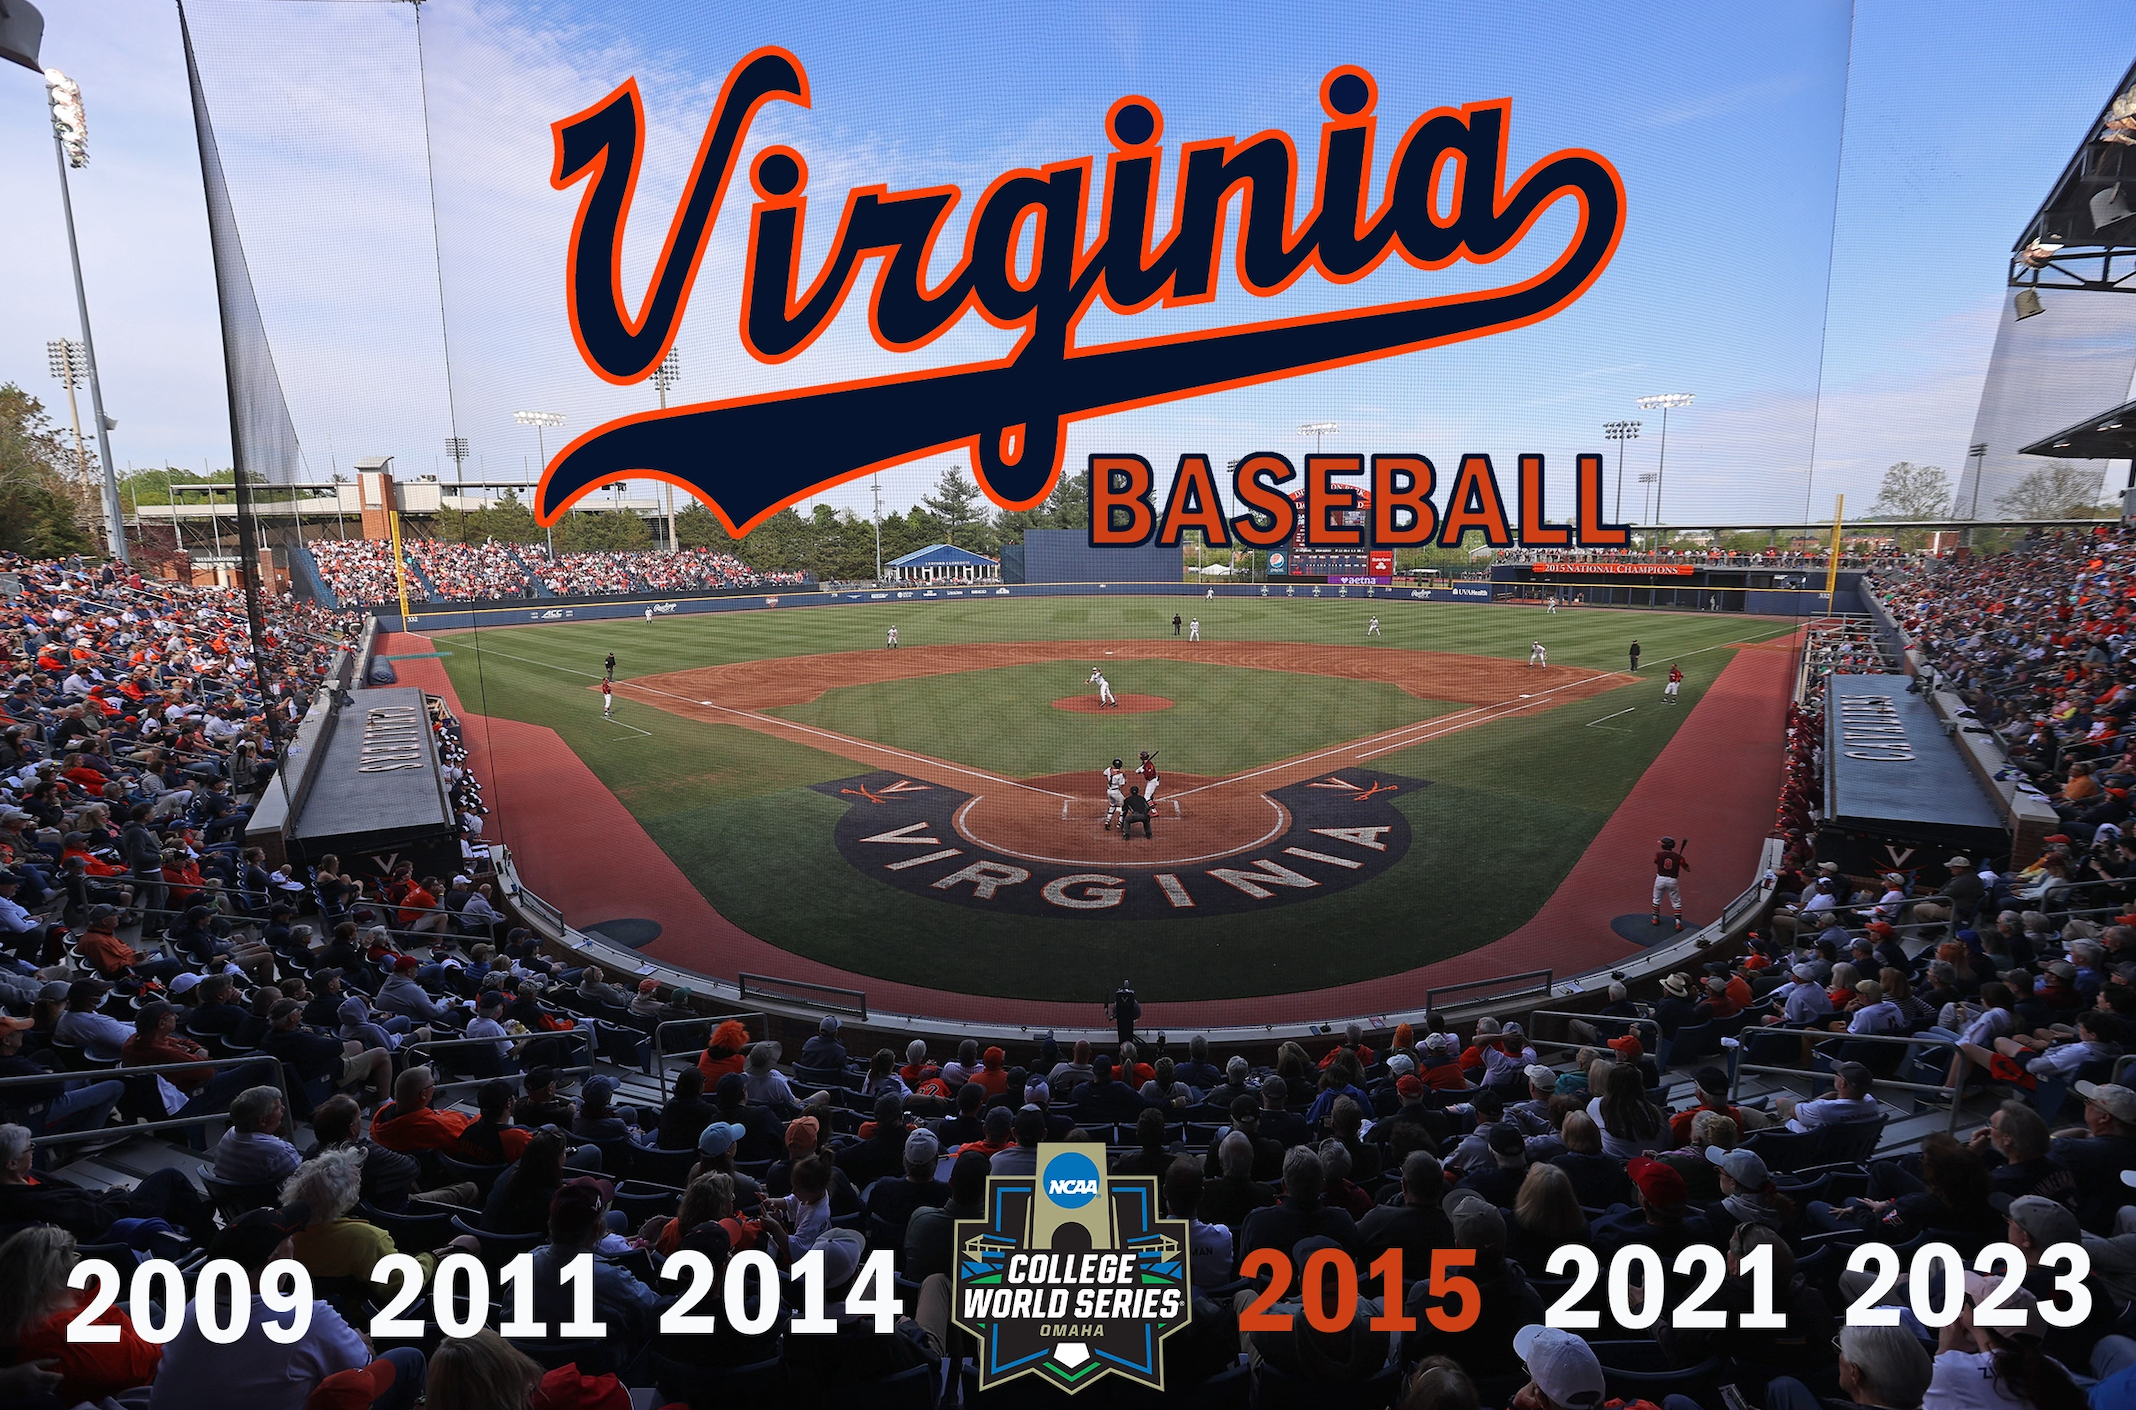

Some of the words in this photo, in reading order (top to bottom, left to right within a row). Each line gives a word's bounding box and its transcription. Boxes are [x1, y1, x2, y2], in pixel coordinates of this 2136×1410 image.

[1545, 564, 1565, 572] 2015
[1567, 564, 1614, 573] NATIONAL
[1617, 564, 1678, 574] CHAMPIONS
[1348, 576, 1376, 584] aetna
[541, 609, 563, 618] ACC
[859, 821, 1392, 910] VIRGINIA
